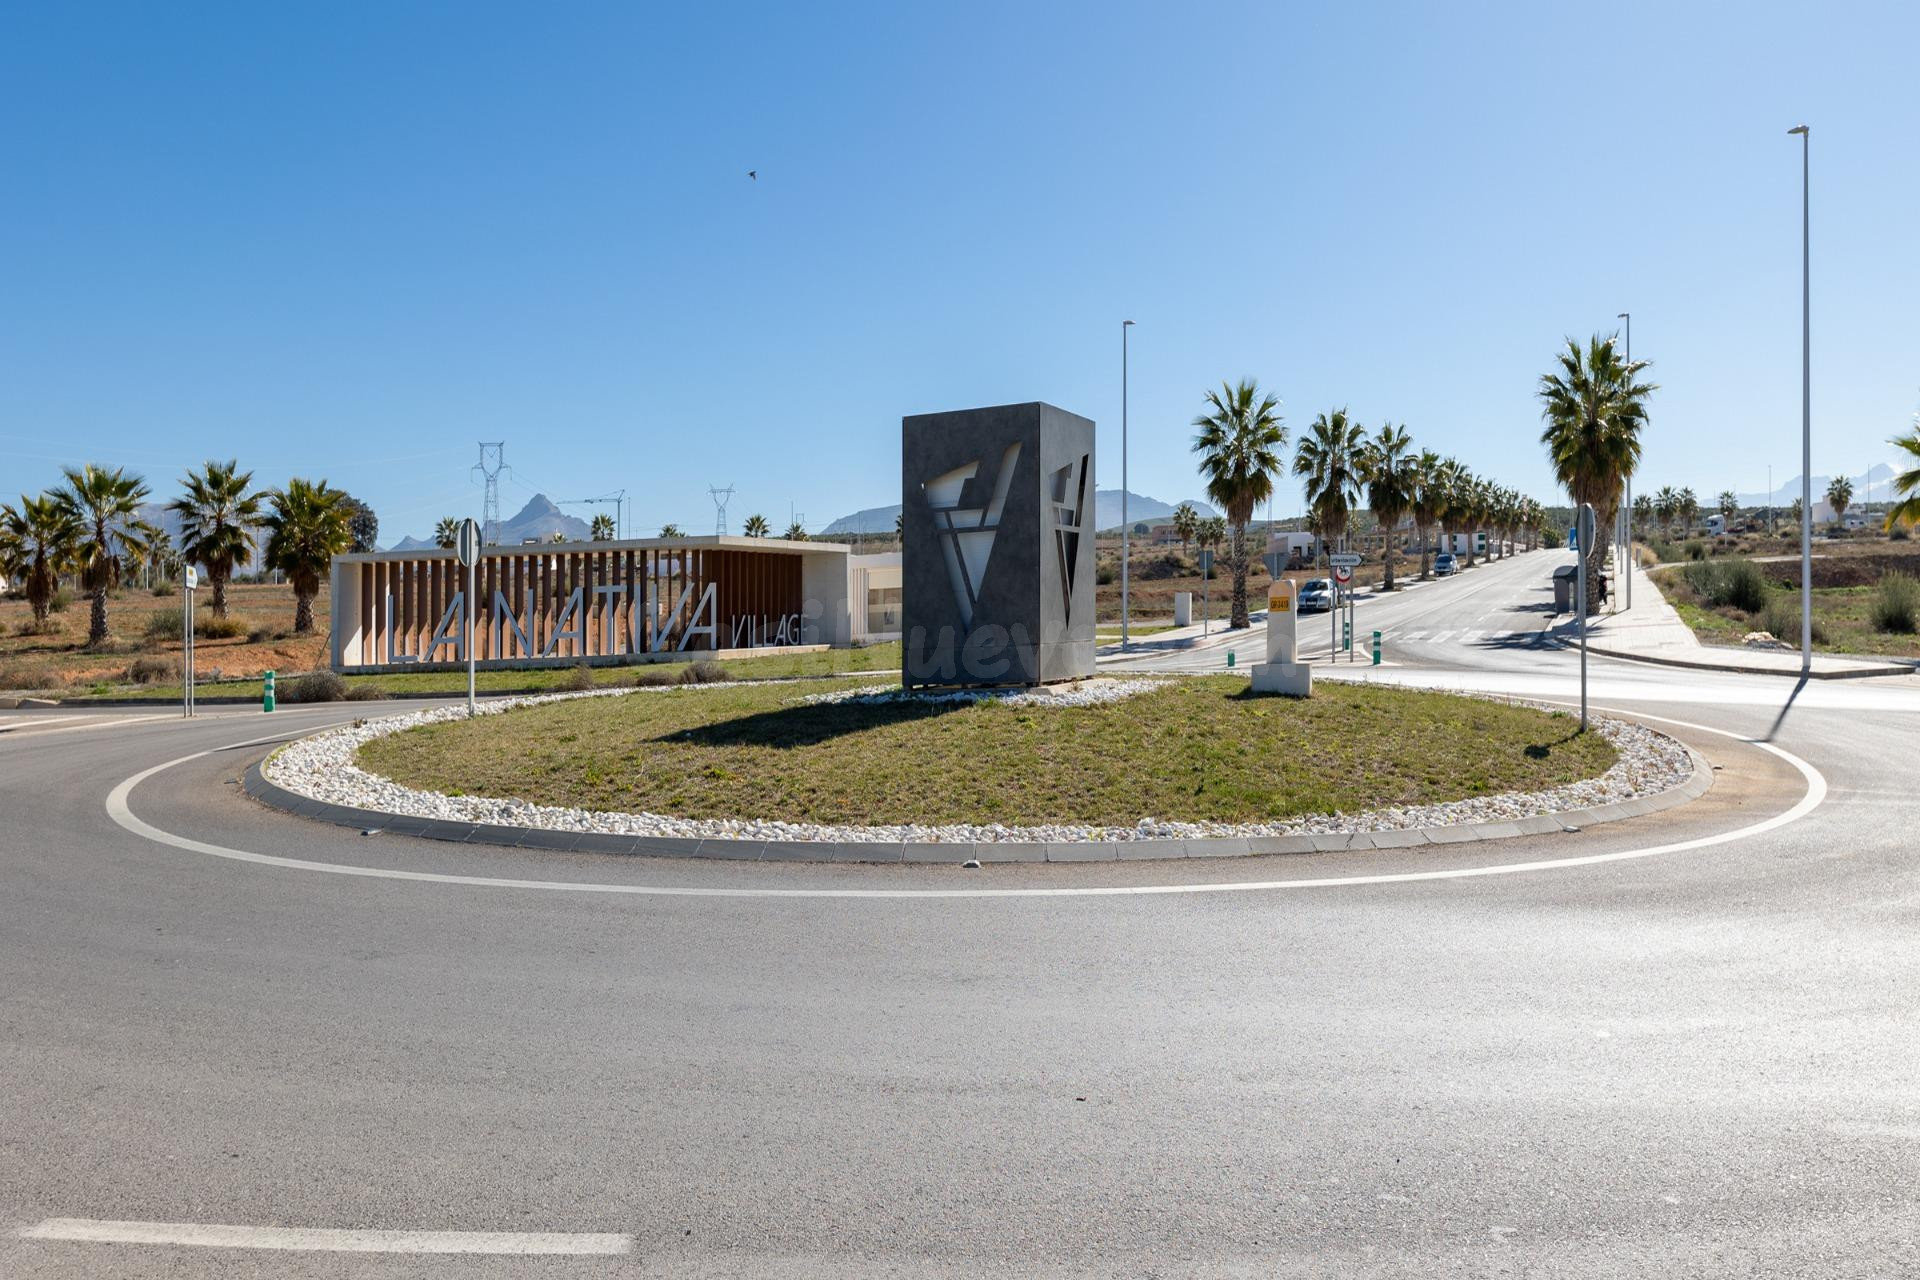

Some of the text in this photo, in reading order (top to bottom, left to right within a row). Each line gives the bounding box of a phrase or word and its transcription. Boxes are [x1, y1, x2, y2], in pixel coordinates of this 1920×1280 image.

[387, 581, 809, 663] LA NATIVA VILLAGE
